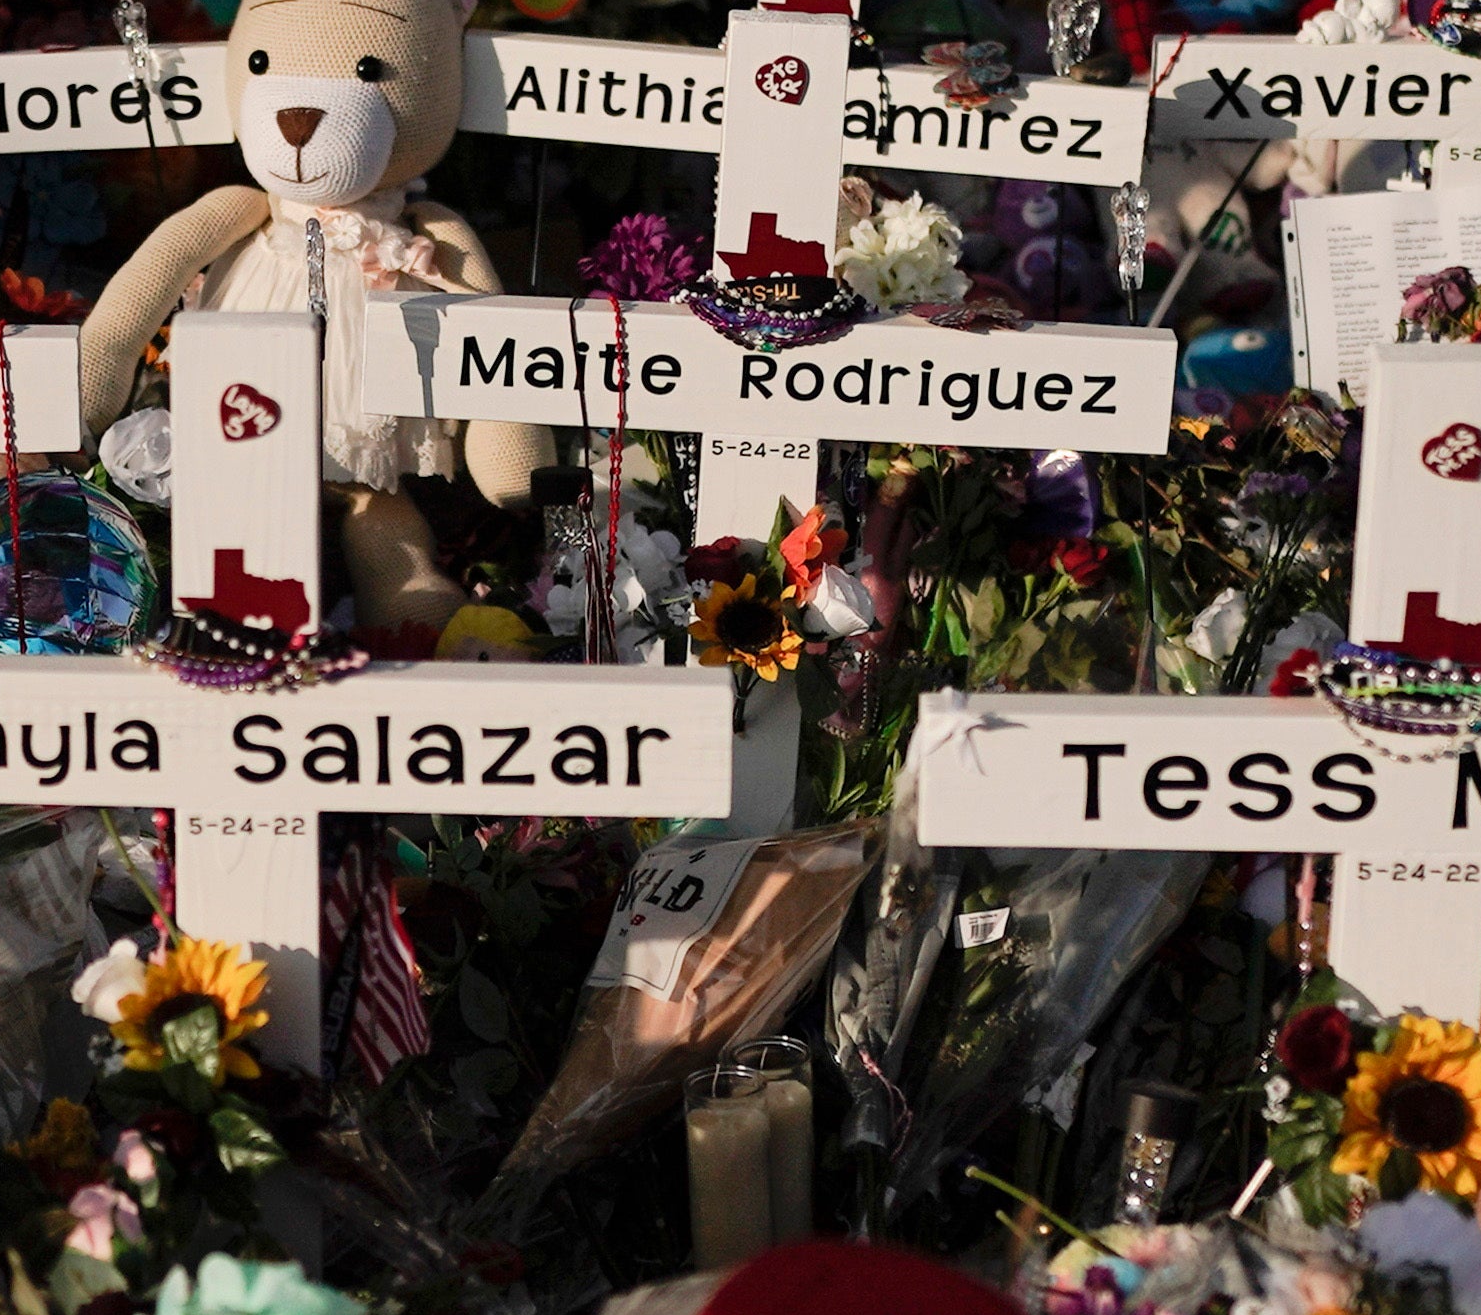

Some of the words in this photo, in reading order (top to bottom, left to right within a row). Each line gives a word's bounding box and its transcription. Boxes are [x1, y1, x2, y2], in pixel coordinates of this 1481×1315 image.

[508, 66, 724, 125] Alithia
[843, 94, 1103, 159] amirez
[1208, 67, 1472, 119] Xavier
[460, 336, 681, 392] Maite
[740, 352, 1118, 416] Rodriguez
[713, 440, 810, 459] 5-24-22
[235, 713, 670, 786] Salazar
[1062, 740, 1378, 822] Tess
[189, 817, 304, 835] 5-24-22
[616, 868, 704, 913] WILD
[1358, 862, 1479, 882] 5-24-22
